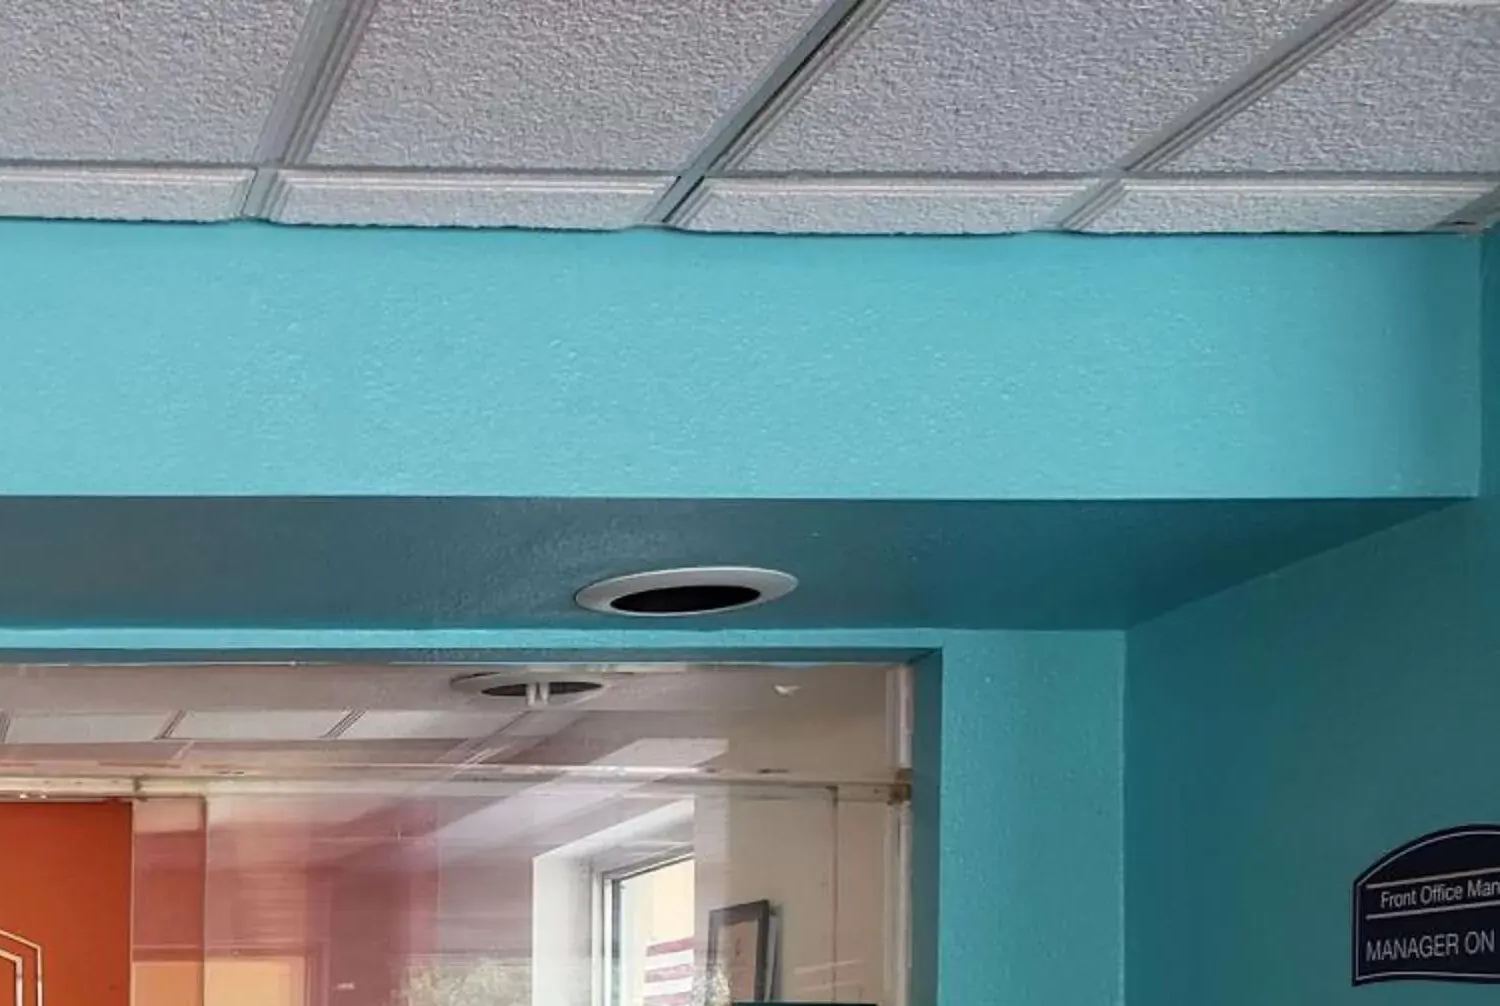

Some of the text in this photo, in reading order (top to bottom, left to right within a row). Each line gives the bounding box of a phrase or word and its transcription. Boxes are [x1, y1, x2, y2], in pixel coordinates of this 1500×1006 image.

[1380, 890, 1417, 909] Front
[1420, 883, 1463, 905] Office
[1365, 929, 1496, 962] MANAGER ON
